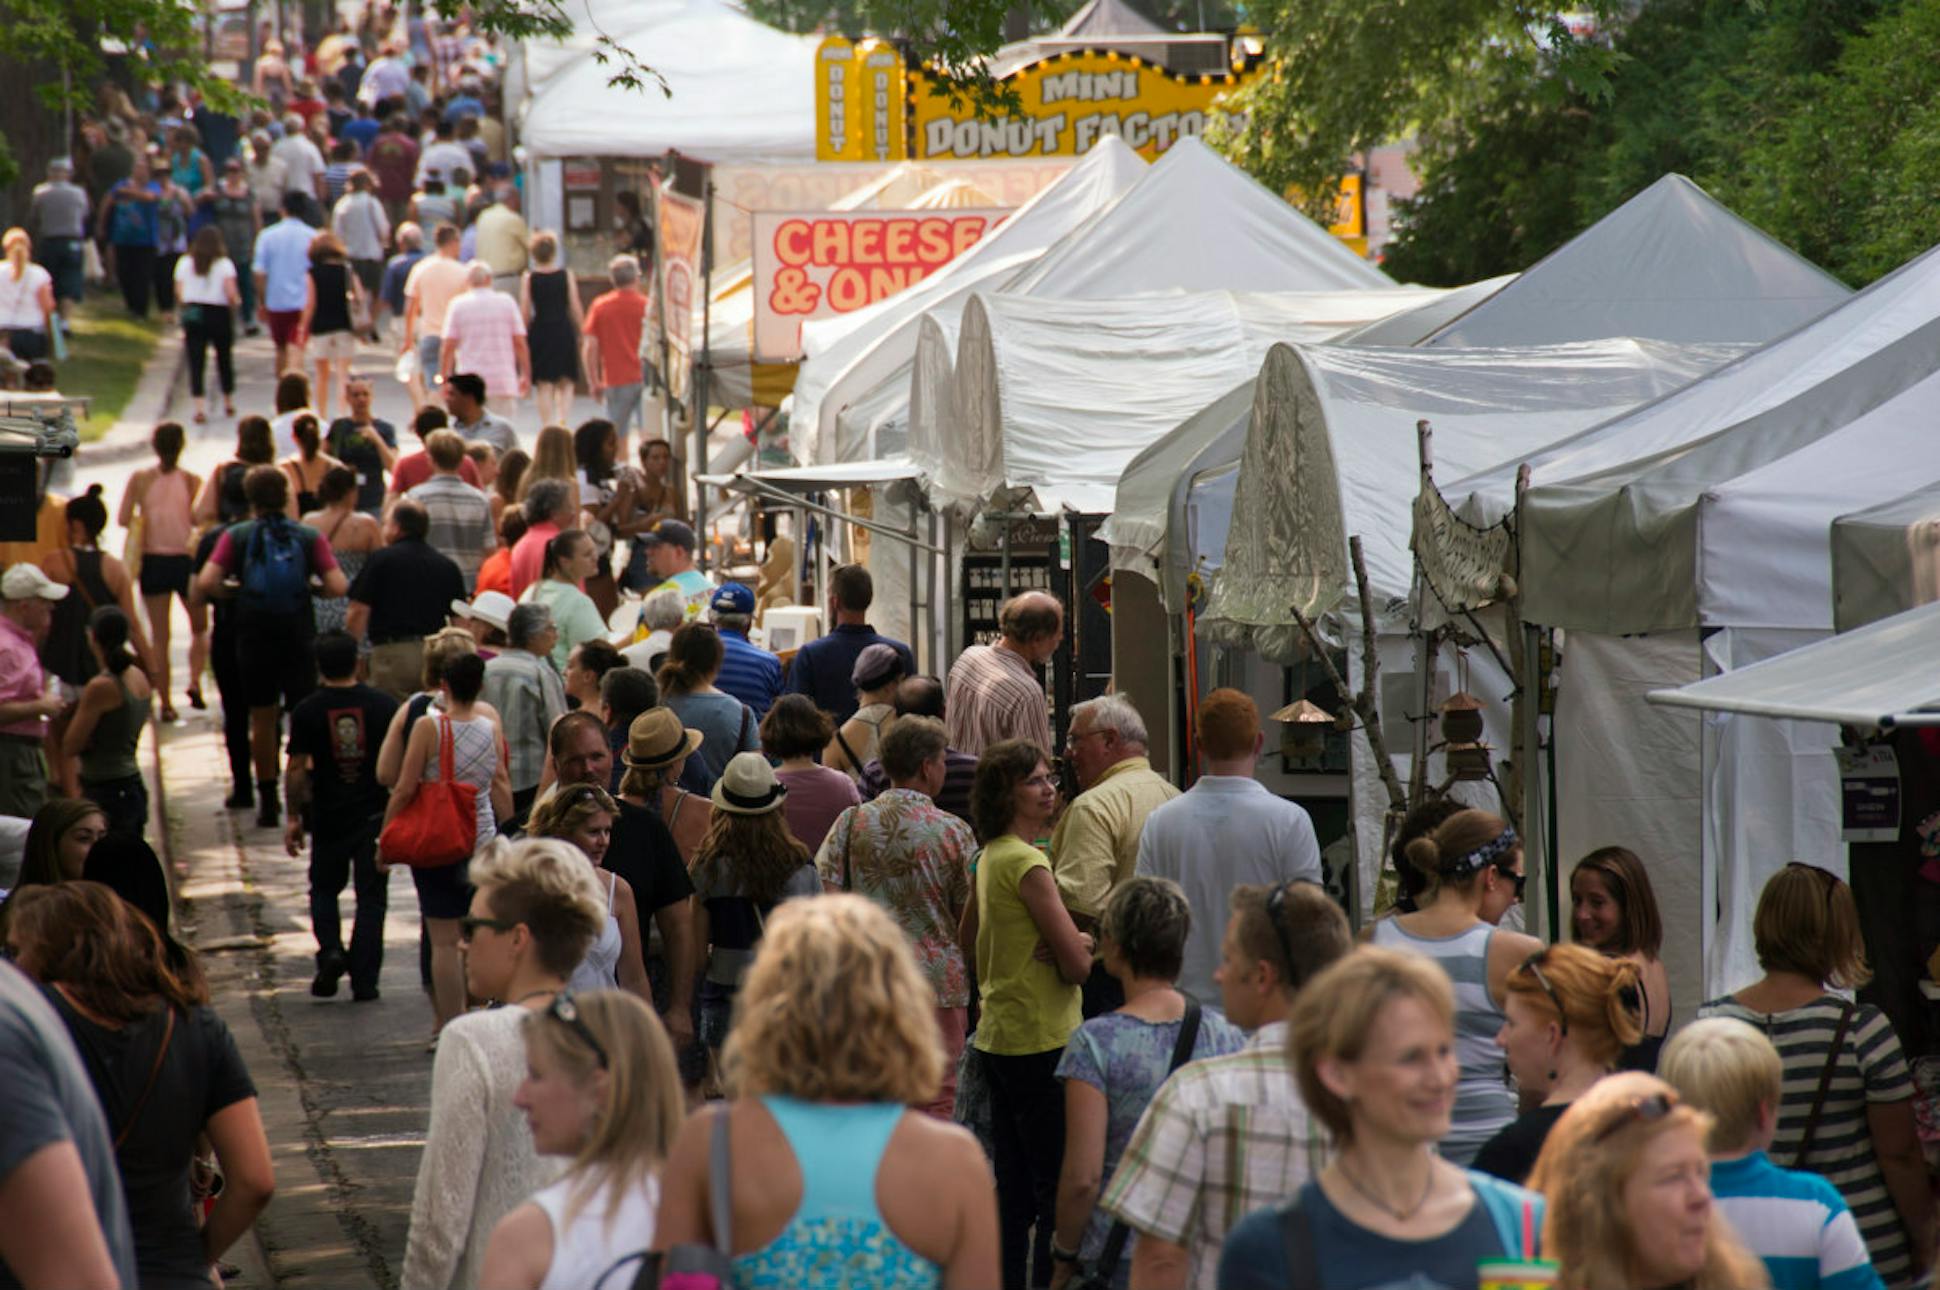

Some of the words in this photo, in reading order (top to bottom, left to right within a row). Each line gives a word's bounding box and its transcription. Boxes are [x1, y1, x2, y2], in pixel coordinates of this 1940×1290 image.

[829, 63, 845, 152] DONUT
[1041, 70, 1140, 104] MINI
[874, 71, 889, 162] DONUT
[925, 113, 1065, 157] DONUT
[1074, 109, 1252, 155] FACTO
[774, 218, 986, 266] CHEESE
[770, 266, 822, 315] &
